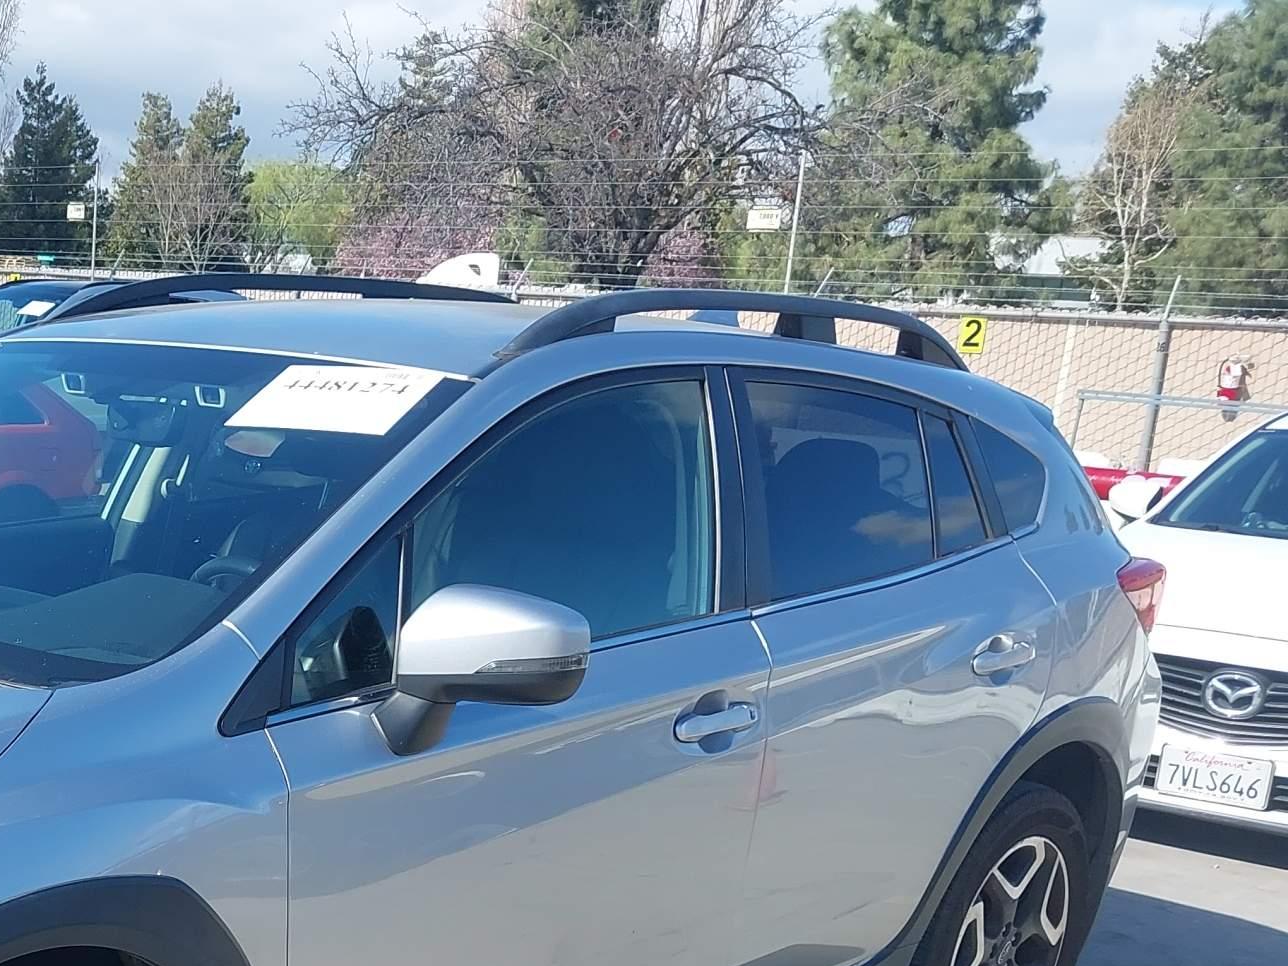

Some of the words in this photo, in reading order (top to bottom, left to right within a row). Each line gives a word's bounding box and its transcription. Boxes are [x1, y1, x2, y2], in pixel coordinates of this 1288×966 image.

[962, 319, 983, 348] 2
[283, 379, 411, 395] 44481274
[1184, 751, 1247, 771] California
[1168, 763, 1262, 799] 7VLS646
